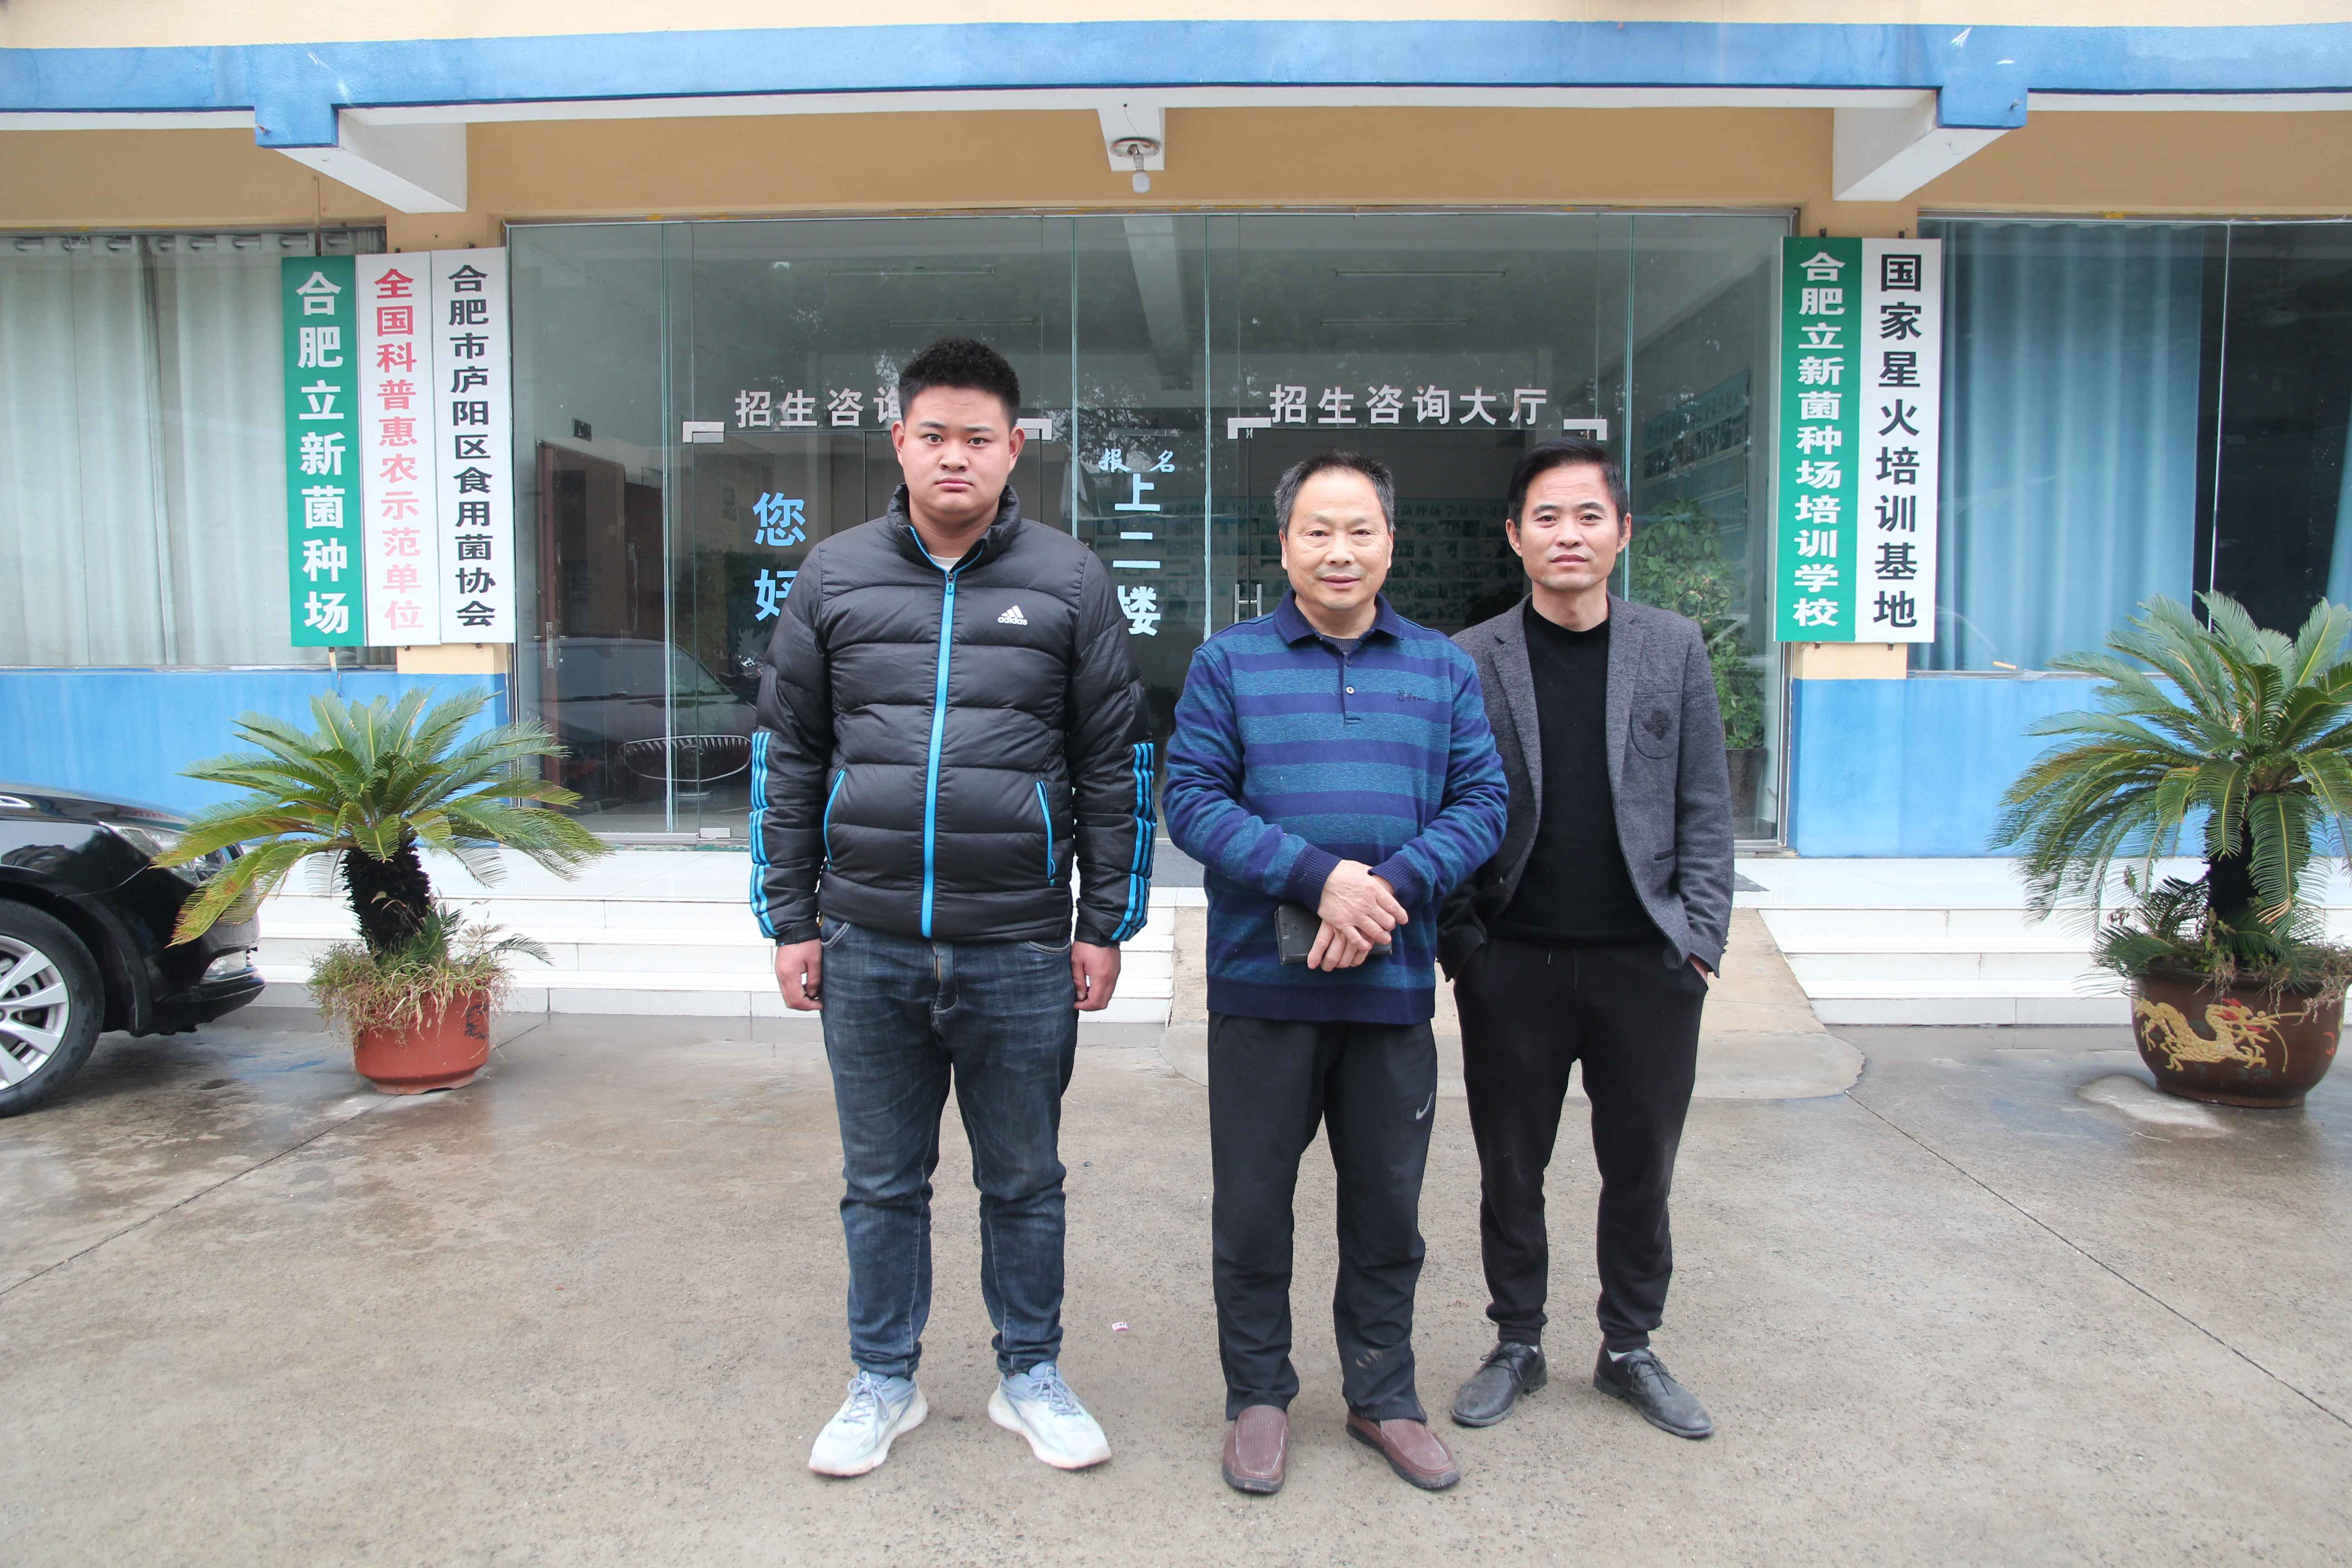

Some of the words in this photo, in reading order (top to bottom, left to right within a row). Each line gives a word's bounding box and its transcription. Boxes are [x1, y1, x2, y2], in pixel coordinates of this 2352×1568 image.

[295, 271, 349, 635] 合肥立新菌种场
[374, 268, 424, 631] 全国科普惠农示范单位
[448, 265, 496, 627] 合肥市庐阳区食用菌协会
[1098, 448, 1176, 474] 报名
[1269, 384, 1548, 426] 招生咨询大厅
[1793, 251, 1846, 627] 合肥立新菌种场培训学校
[1872, 254, 1923, 629] 国家星火培训基地
[752, 491, 807, 622] 您好
[998, 617, 1028, 626] adidas
[1112, 473, 1161, 636] 上二楼
